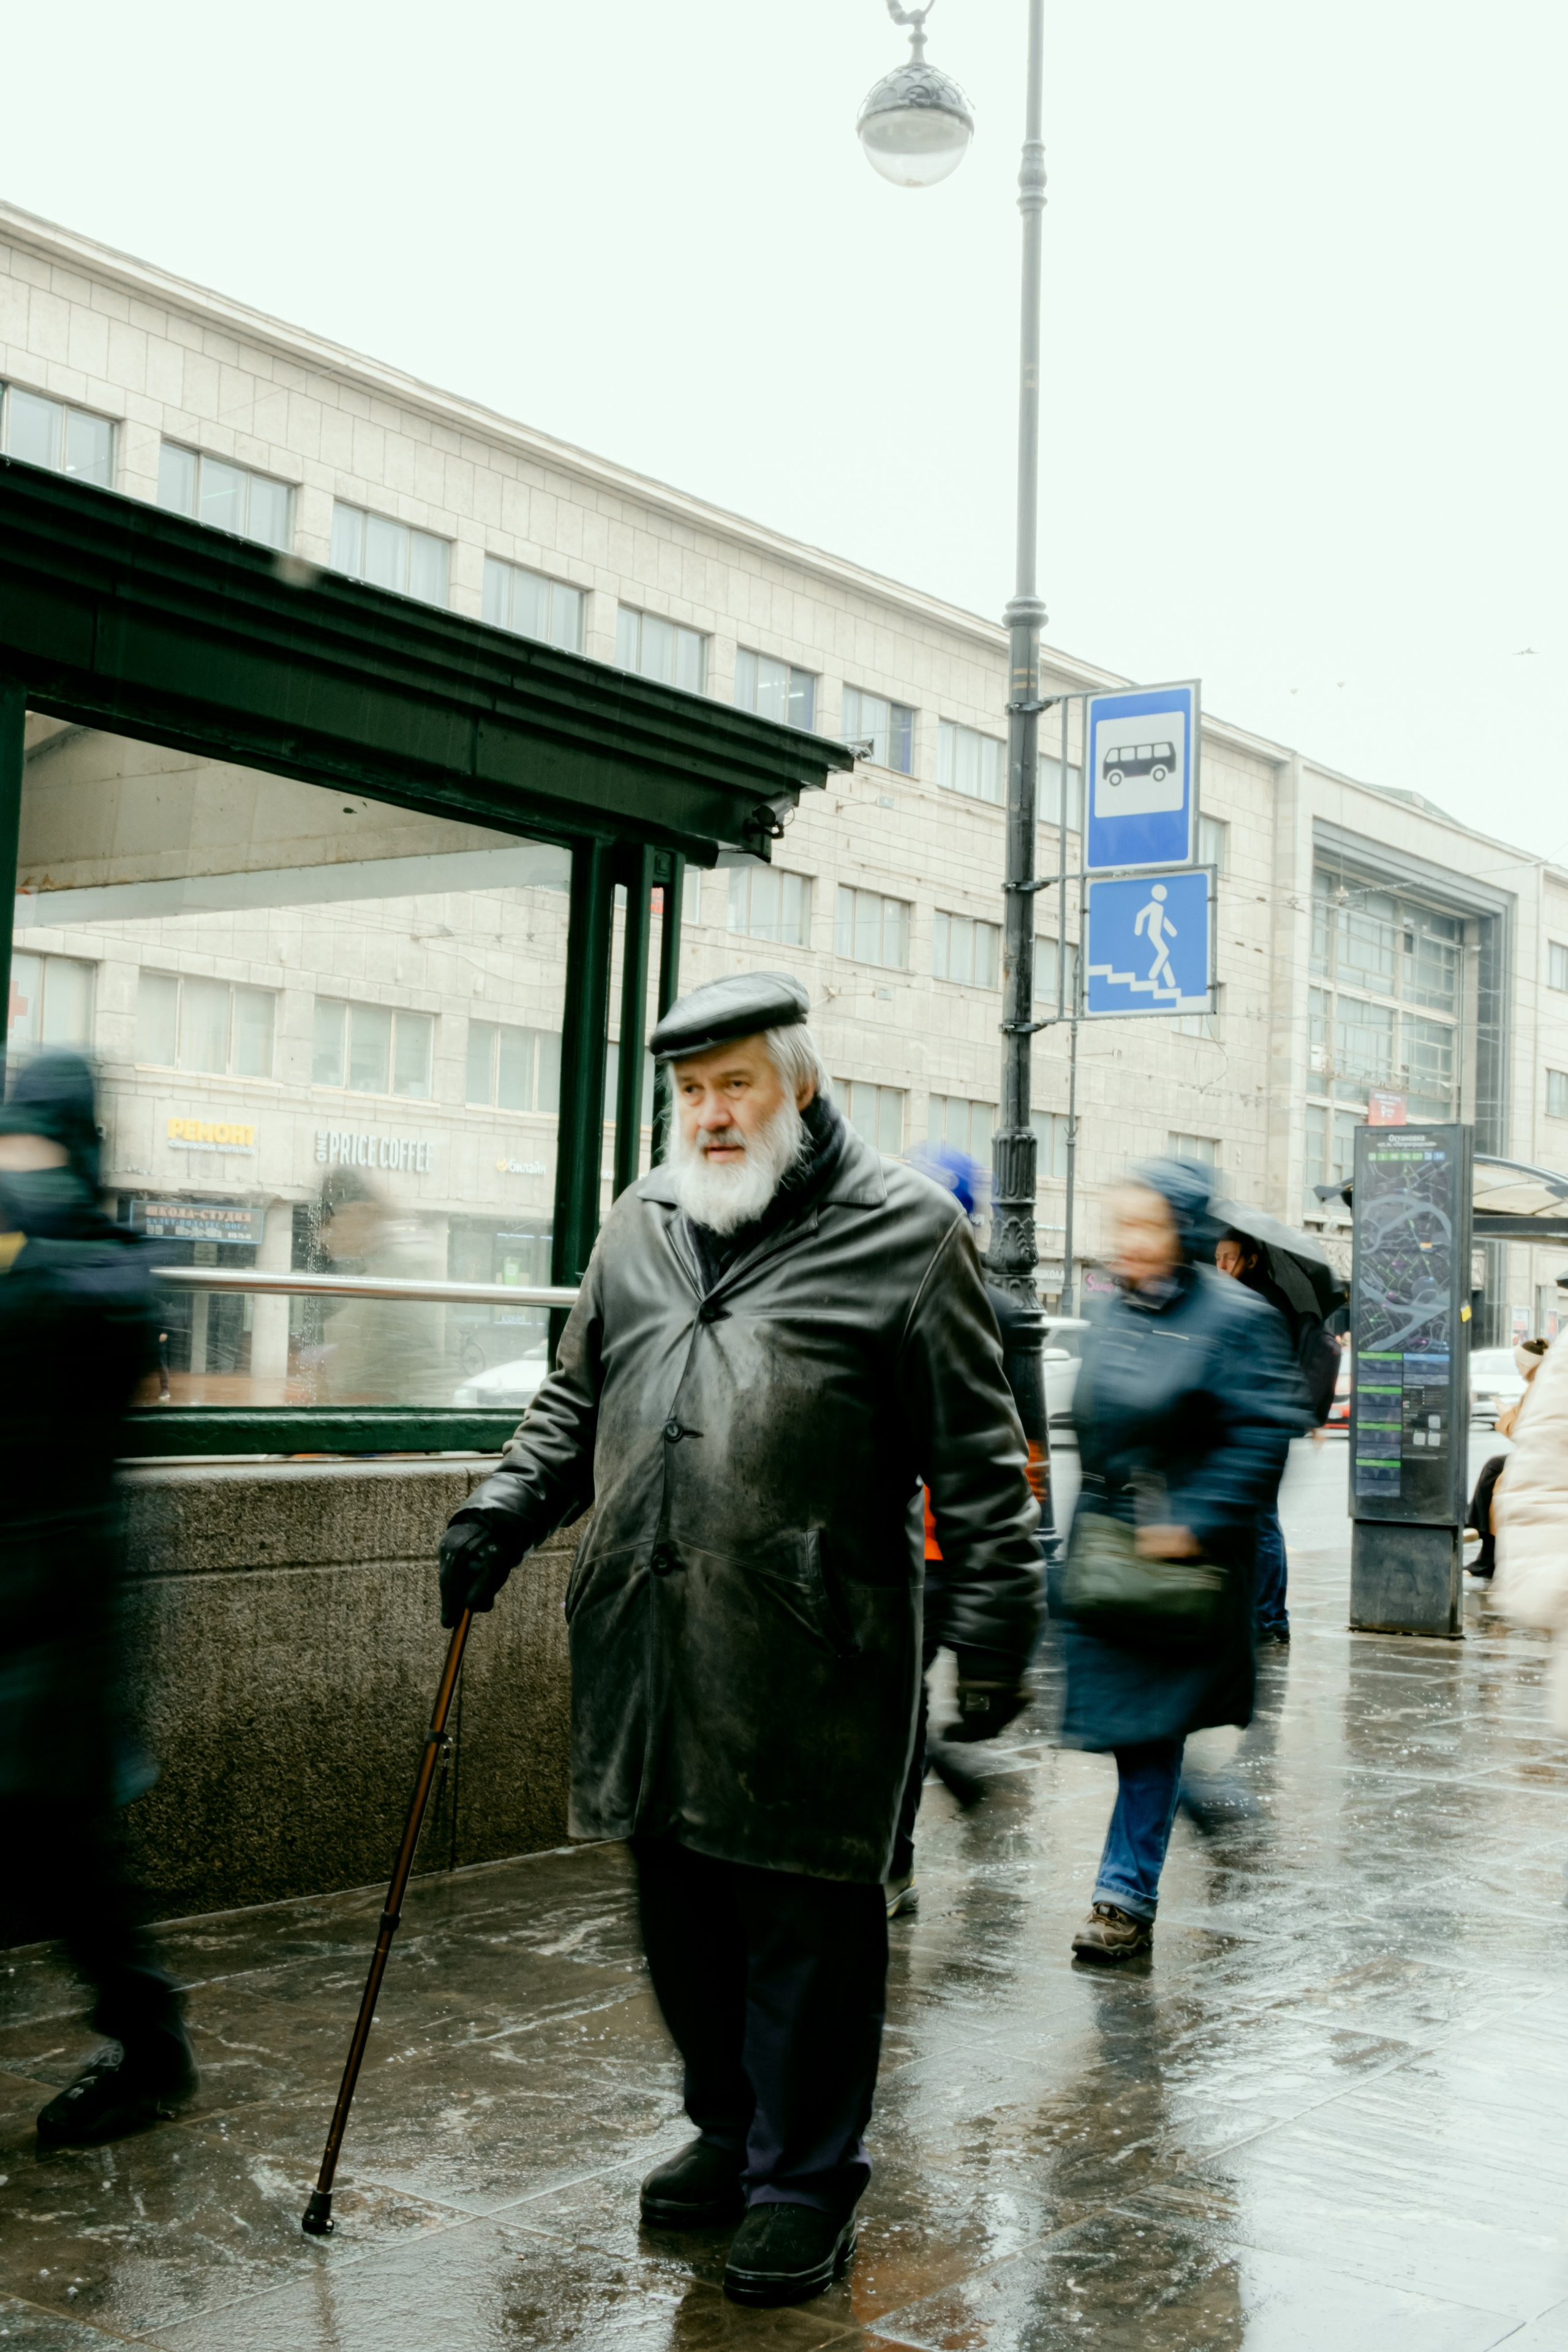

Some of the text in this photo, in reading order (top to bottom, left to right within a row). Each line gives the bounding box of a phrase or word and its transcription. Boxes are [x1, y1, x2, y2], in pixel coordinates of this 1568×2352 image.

[168, 1117, 256, 1146] РЕМОНТ
[316, 1130, 328, 1162] ONE
[329, 1132, 434, 1172] PRICE COFFEE
[508, 1158, 546, 1174] билайн
[146, 1205, 251, 1223] ШКОЛА-СТУДИЯ
